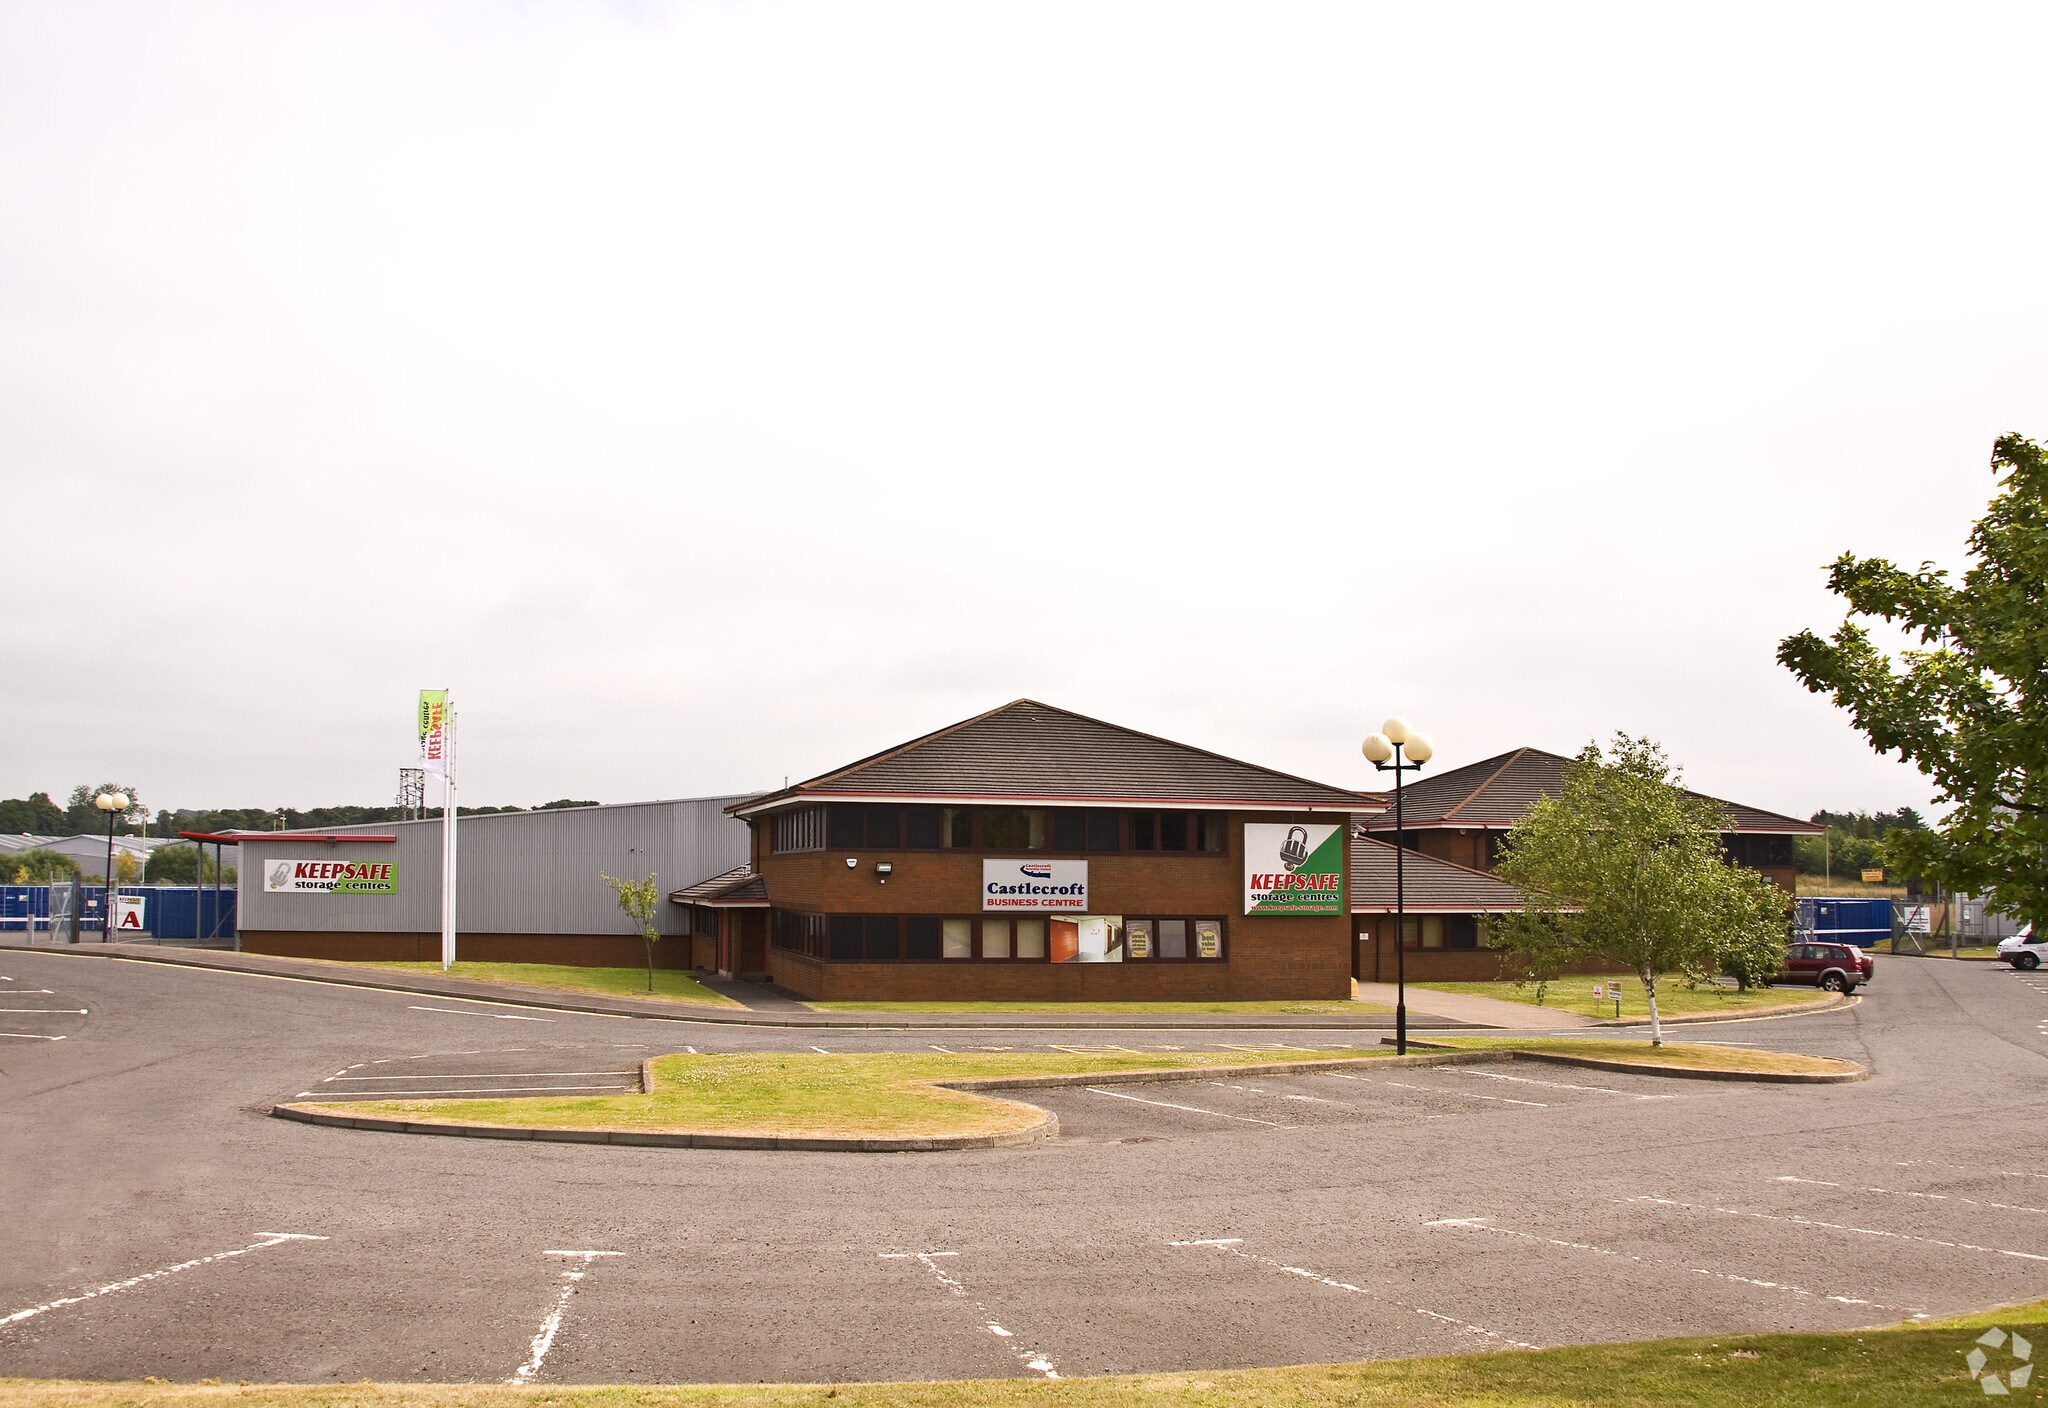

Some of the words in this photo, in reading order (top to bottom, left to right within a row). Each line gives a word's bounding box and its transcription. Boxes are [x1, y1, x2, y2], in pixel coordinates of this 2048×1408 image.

[294, 863, 392, 880] KEEPSAFE
[294, 881, 341, 890] storage
[346, 881, 391, 890] centres
[1250, 873, 1339, 890] KEEPSAFE
[987, 882, 1084, 895] Castlecroft
[987, 898, 1038, 906] BUSINESS
[1041, 899, 1083, 907] CENTRE
[1250, 893, 1293, 902] storage
[1297, 893, 1338, 901] centres
[121, 911, 140, 927] A
